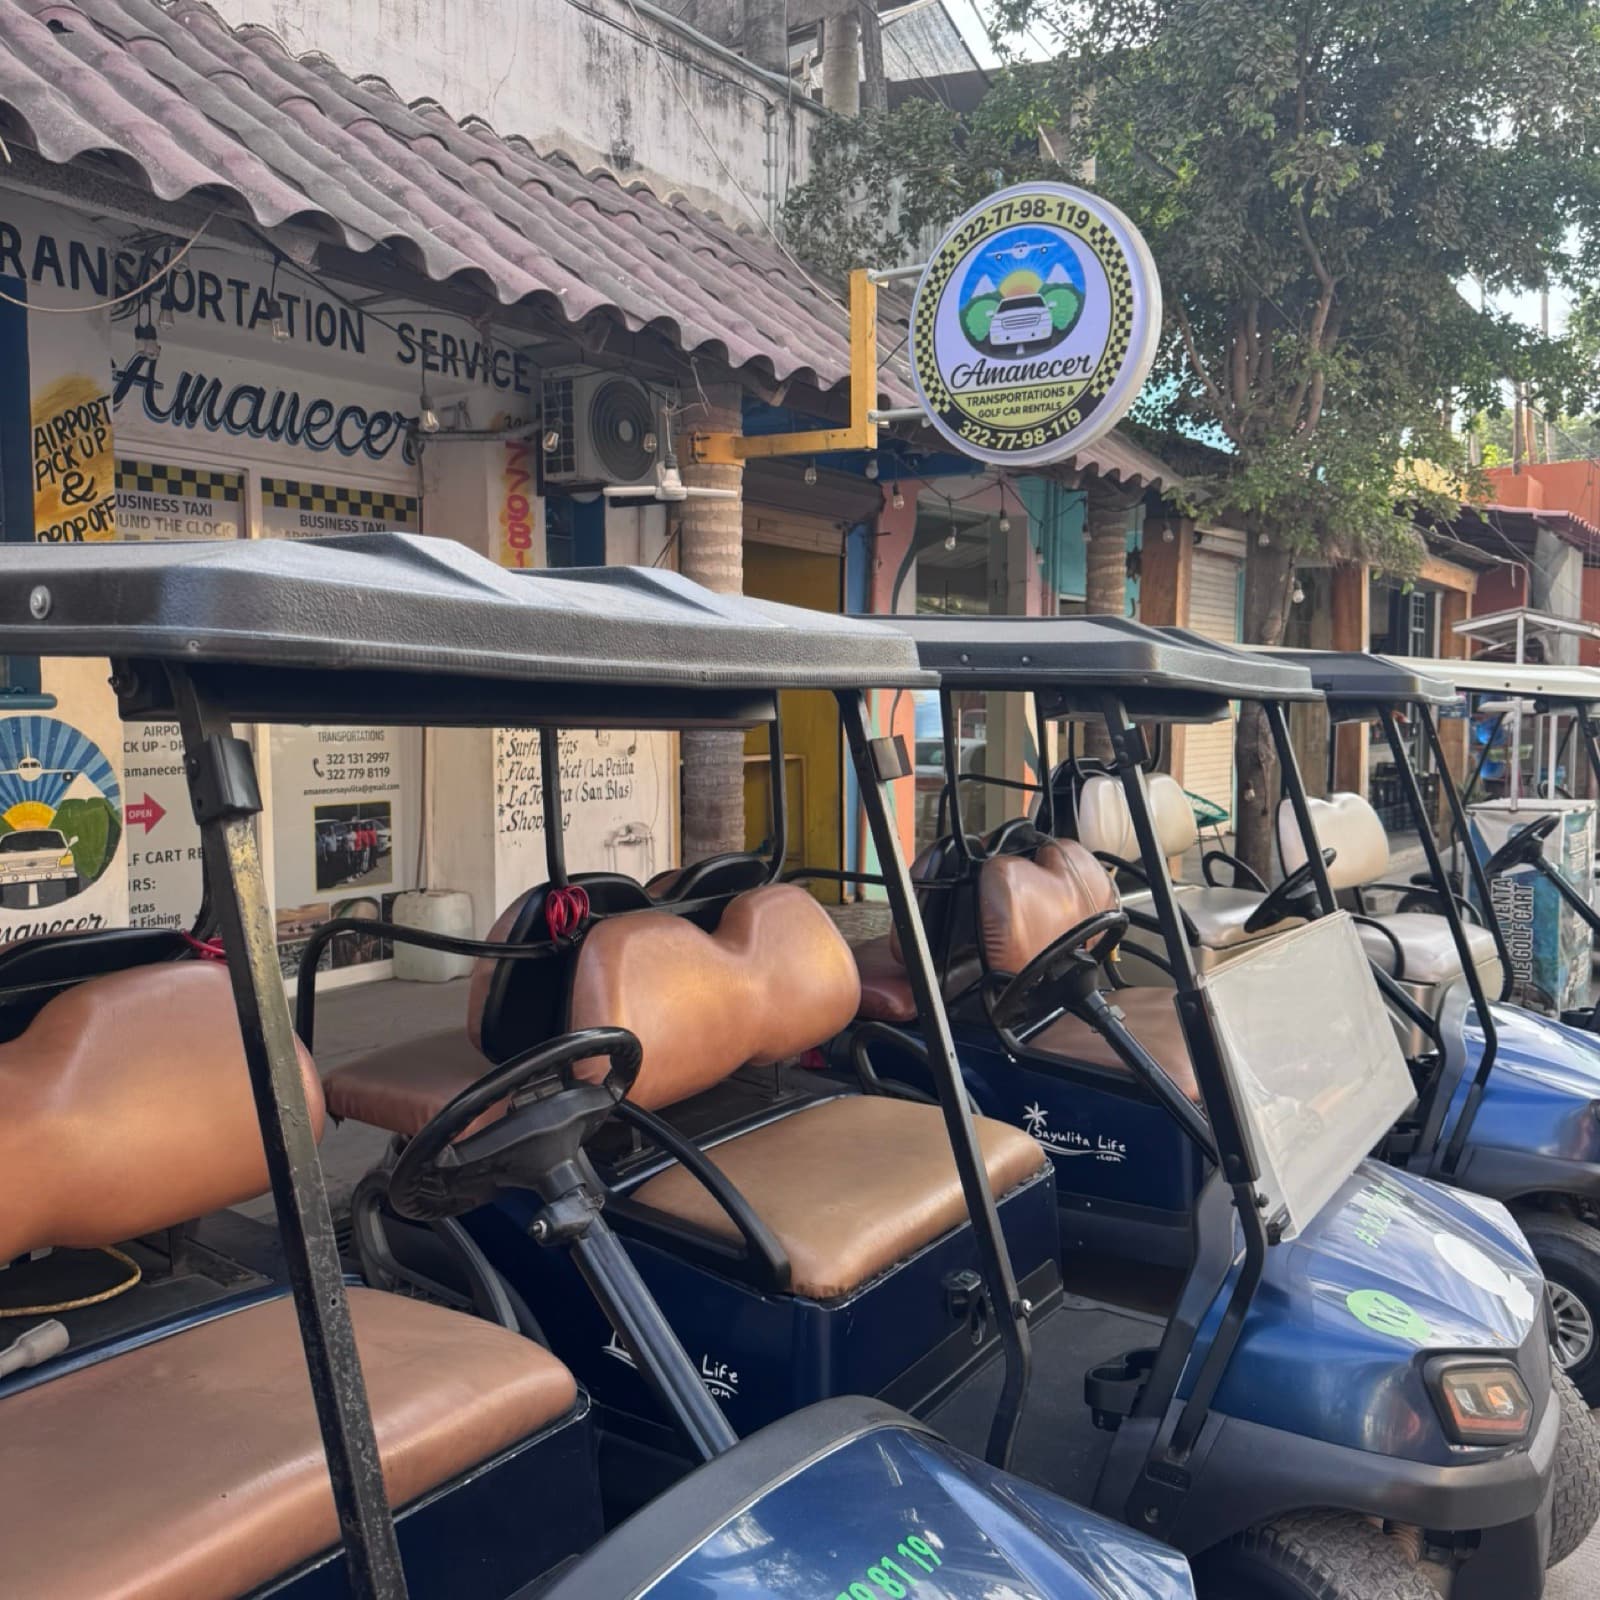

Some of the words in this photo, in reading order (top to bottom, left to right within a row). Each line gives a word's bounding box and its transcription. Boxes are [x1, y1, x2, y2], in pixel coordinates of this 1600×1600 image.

[397, 321, 531, 395] SERVICE
[950, 354, 1093, 389] Amanecer
[111, 350, 420, 465] Amanecer
[966, 388, 1065, 408] TRANSPORTATIONS
[1066, 385, 1076, 397] &
[977, 407, 1002, 419] GOLF
[1002, 405, 1021, 416] CAR
[1022, 401, 1062, 415] RENTALS
[34, 395, 112, 459] AIRPORT
[958, 407, 1083, 450] 322-77-98-119
[35, 444, 80, 491] PICK
[79, 427, 107, 459] UP
[61, 471, 98, 506] &
[115, 494, 180, 514] USINESS
[182, 500, 213, 517] TAXI
[115, 513, 151, 530] UND
[154, 515, 183, 533] THE
[299, 514, 359, 532] BUSINESS
[362, 521, 385, 533] TAXI
[143, 725, 180, 737] AIRPO
[318, 730, 385, 742] TRANSPORTATIONS
[123, 741, 139, 753] CK
[142, 740, 159, 753] UP
[506, 736, 541, 758] Surfi
[558, 737, 578, 758] rips
[326, 753, 345, 765] 322
[347, 753, 364, 764] 131
[366, 752, 390, 764] 2997
[326, 768, 345, 780] 322
[348, 768, 365, 779] 779
[367, 767, 390, 779] 8119
[505, 761, 535, 782] Flea
[506, 785, 528, 808] La
[575, 780, 602, 802] (San
[128, 808, 153, 818] OPEN
[506, 809, 571, 833] Shopg
[145, 849, 182, 865] CART
[128, 878, 156, 891] RS:
[129, 903, 156, 915] etas
[1491, 878, 1512, 922] VENTA
[1512, 882, 1534, 923] CART
[140, 912, 181, 927] Fishing
[1512, 924, 1533, 961] GOLF
[1034, 1125, 1090, 1146] Sayulita
[1098, 1135, 1126, 1152] Life
[702, 1353, 739, 1384] Life
